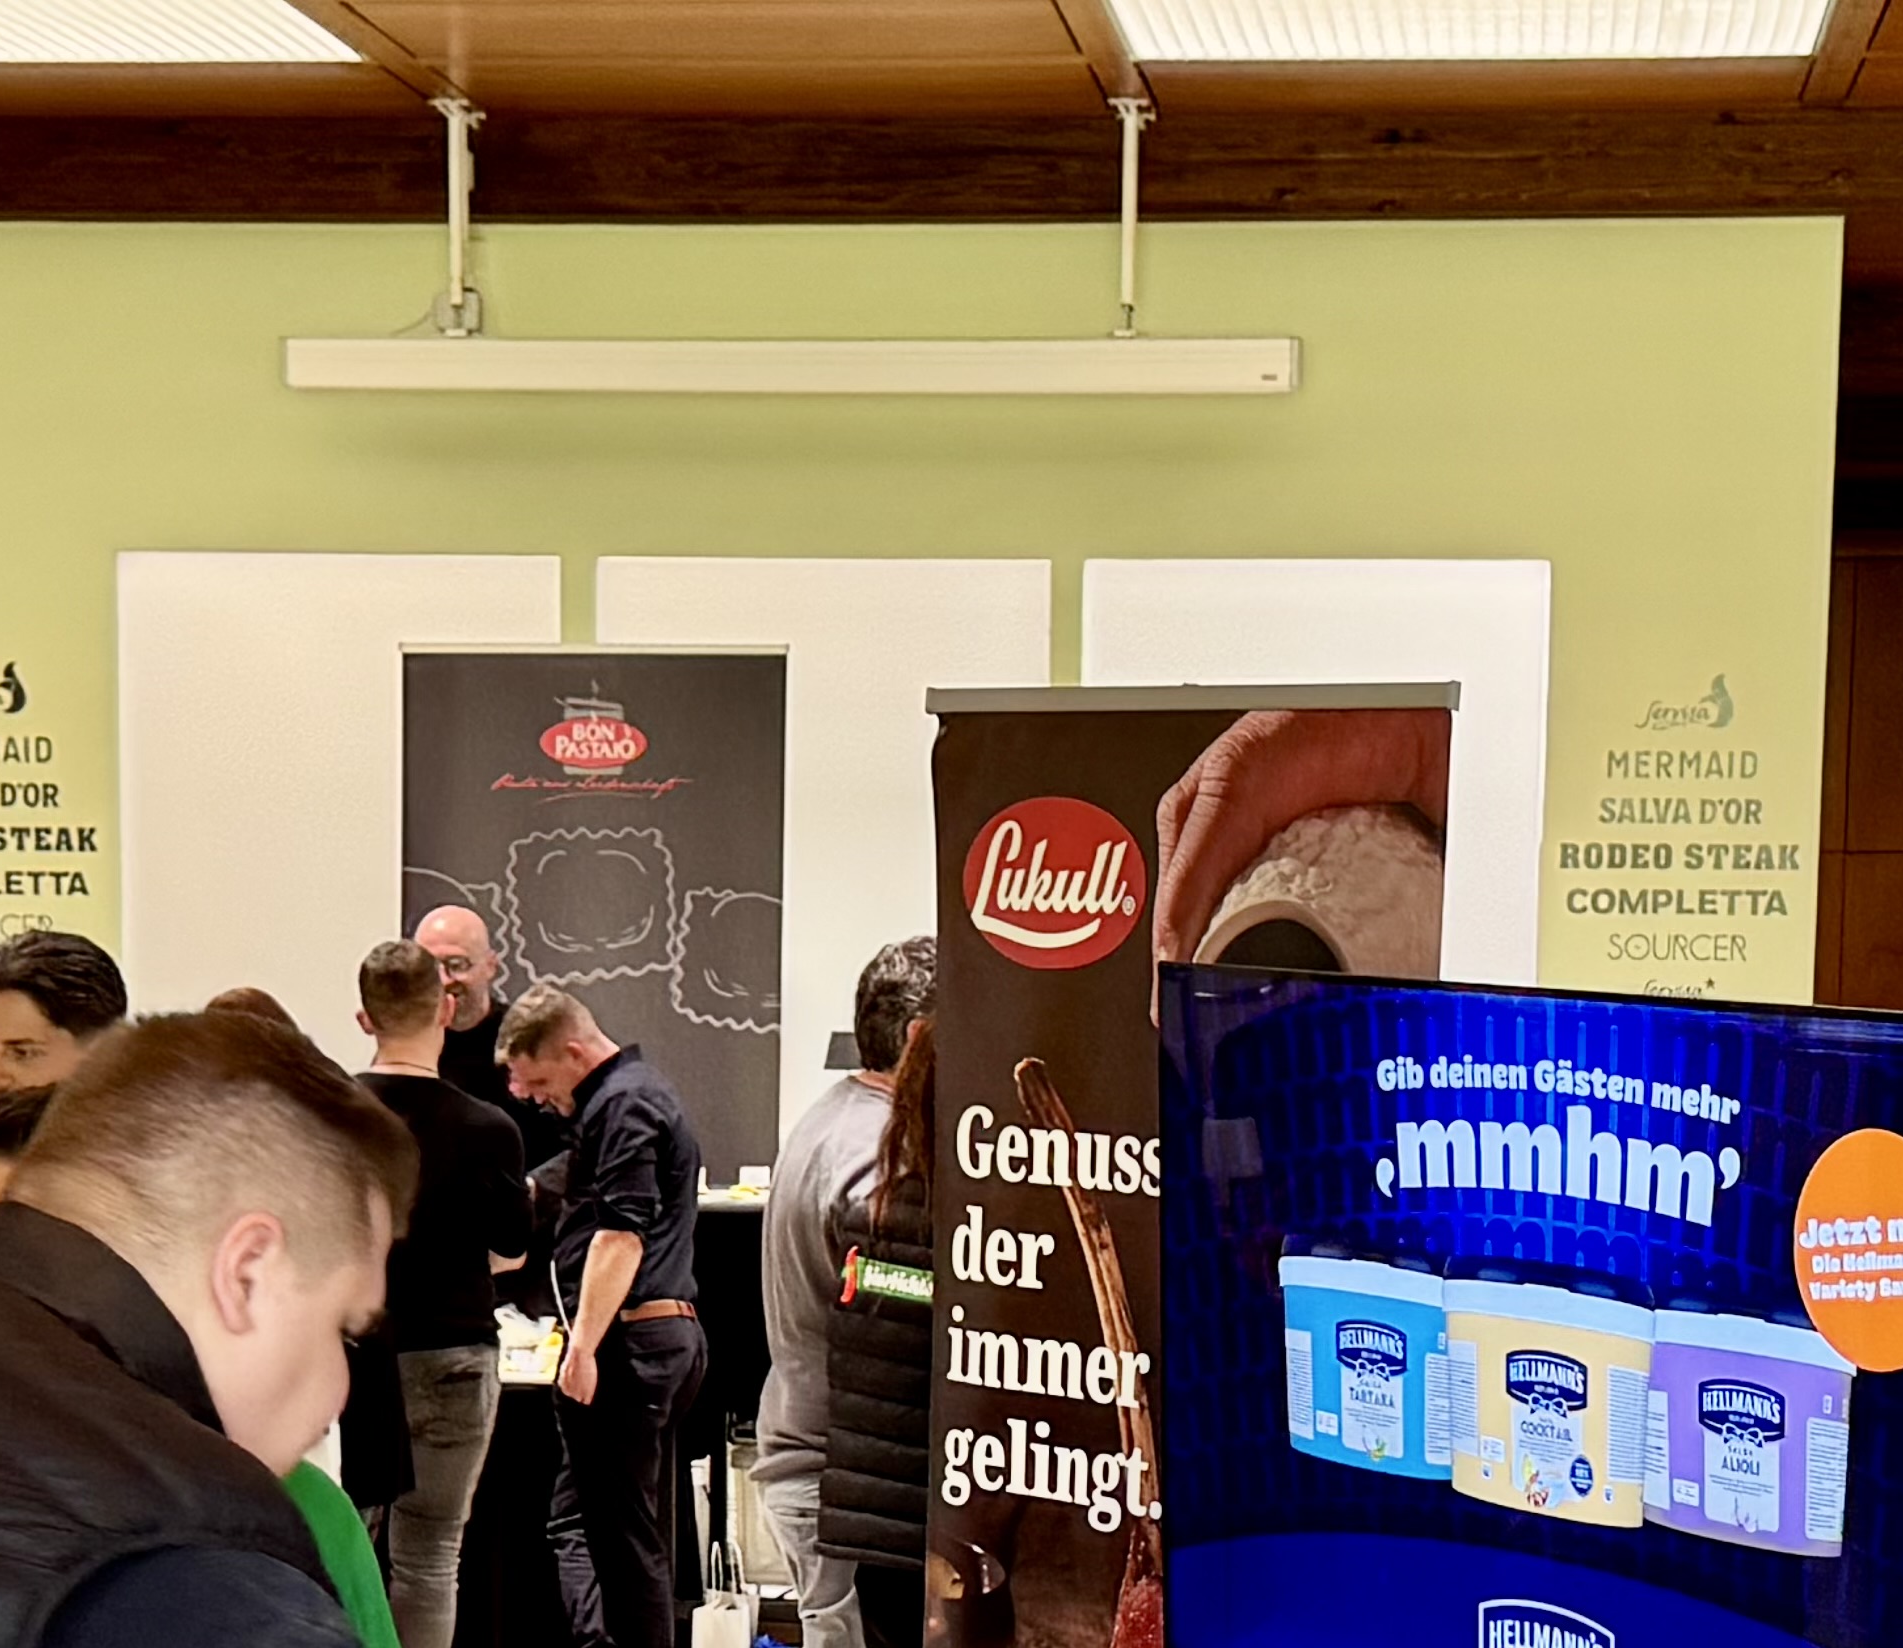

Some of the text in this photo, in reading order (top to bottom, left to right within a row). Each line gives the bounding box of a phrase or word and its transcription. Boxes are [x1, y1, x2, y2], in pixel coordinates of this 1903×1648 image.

[572, 722, 615, 741] BON
[1606, 750, 1759, 779] MERMAID
[0, 782, 59, 808] D'OR
[1598, 798, 1763, 825] SALVA D'OR
[1559, 842, 1801, 870] RODEO STEAK
[971, 819, 1127, 949] Lukull
[1566, 888, 1788, 916] COMPLETTA
[1607, 932, 1747, 962] SOURCER
[1377, 1054, 1741, 1125] Gib deinen Gästen mehr
[956, 1105, 1160, 1197] Genuss
[951, 1205, 1055, 1289] der
[1799, 1216, 1882, 1248] Jetzt
[946, 1305, 1150, 1409] immer
[941, 1418, 1162, 1533] gelingt.
